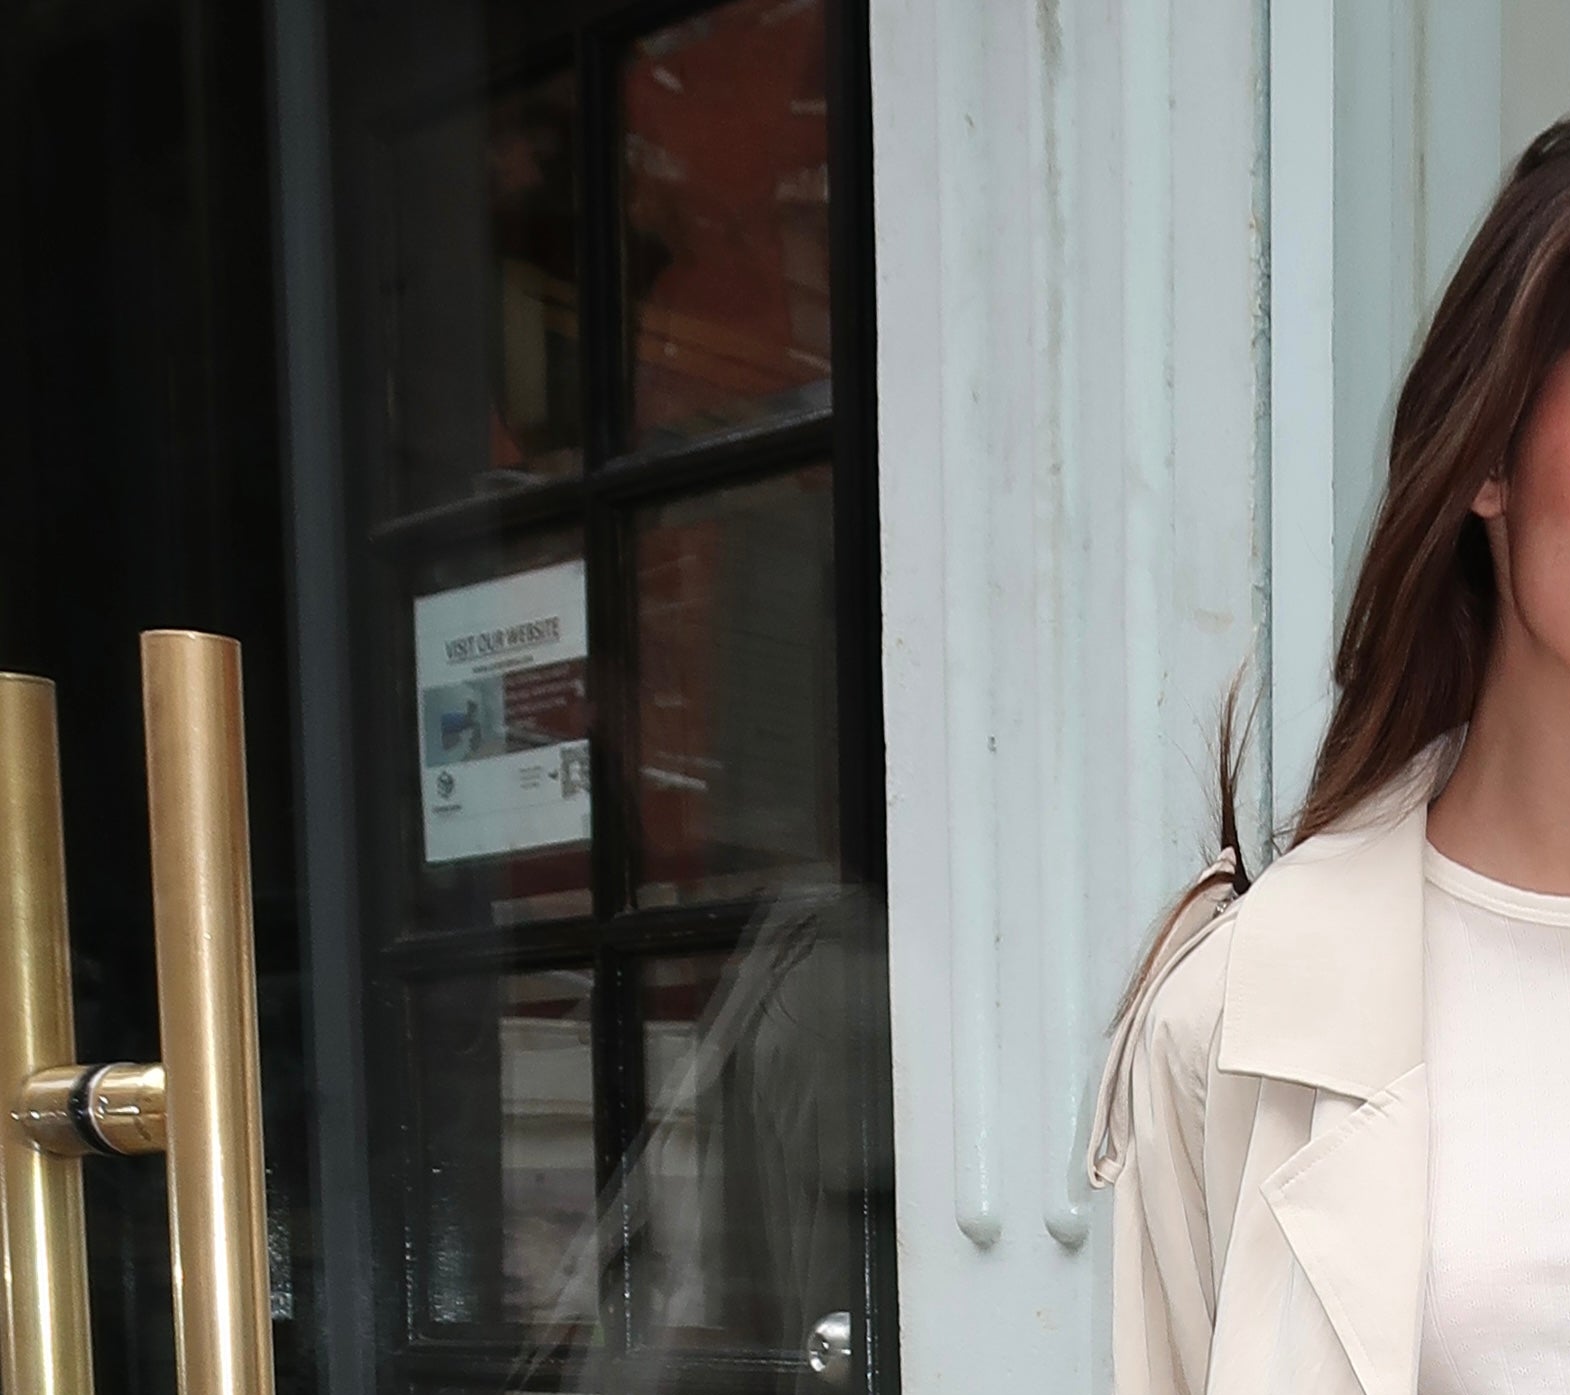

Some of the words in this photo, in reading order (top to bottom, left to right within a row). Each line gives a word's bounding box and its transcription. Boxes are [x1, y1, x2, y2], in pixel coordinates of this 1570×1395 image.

[445, 635, 475, 659] VISIT
[477, 630, 504, 652] OUR
[506, 616, 560, 645] WEBSITE
